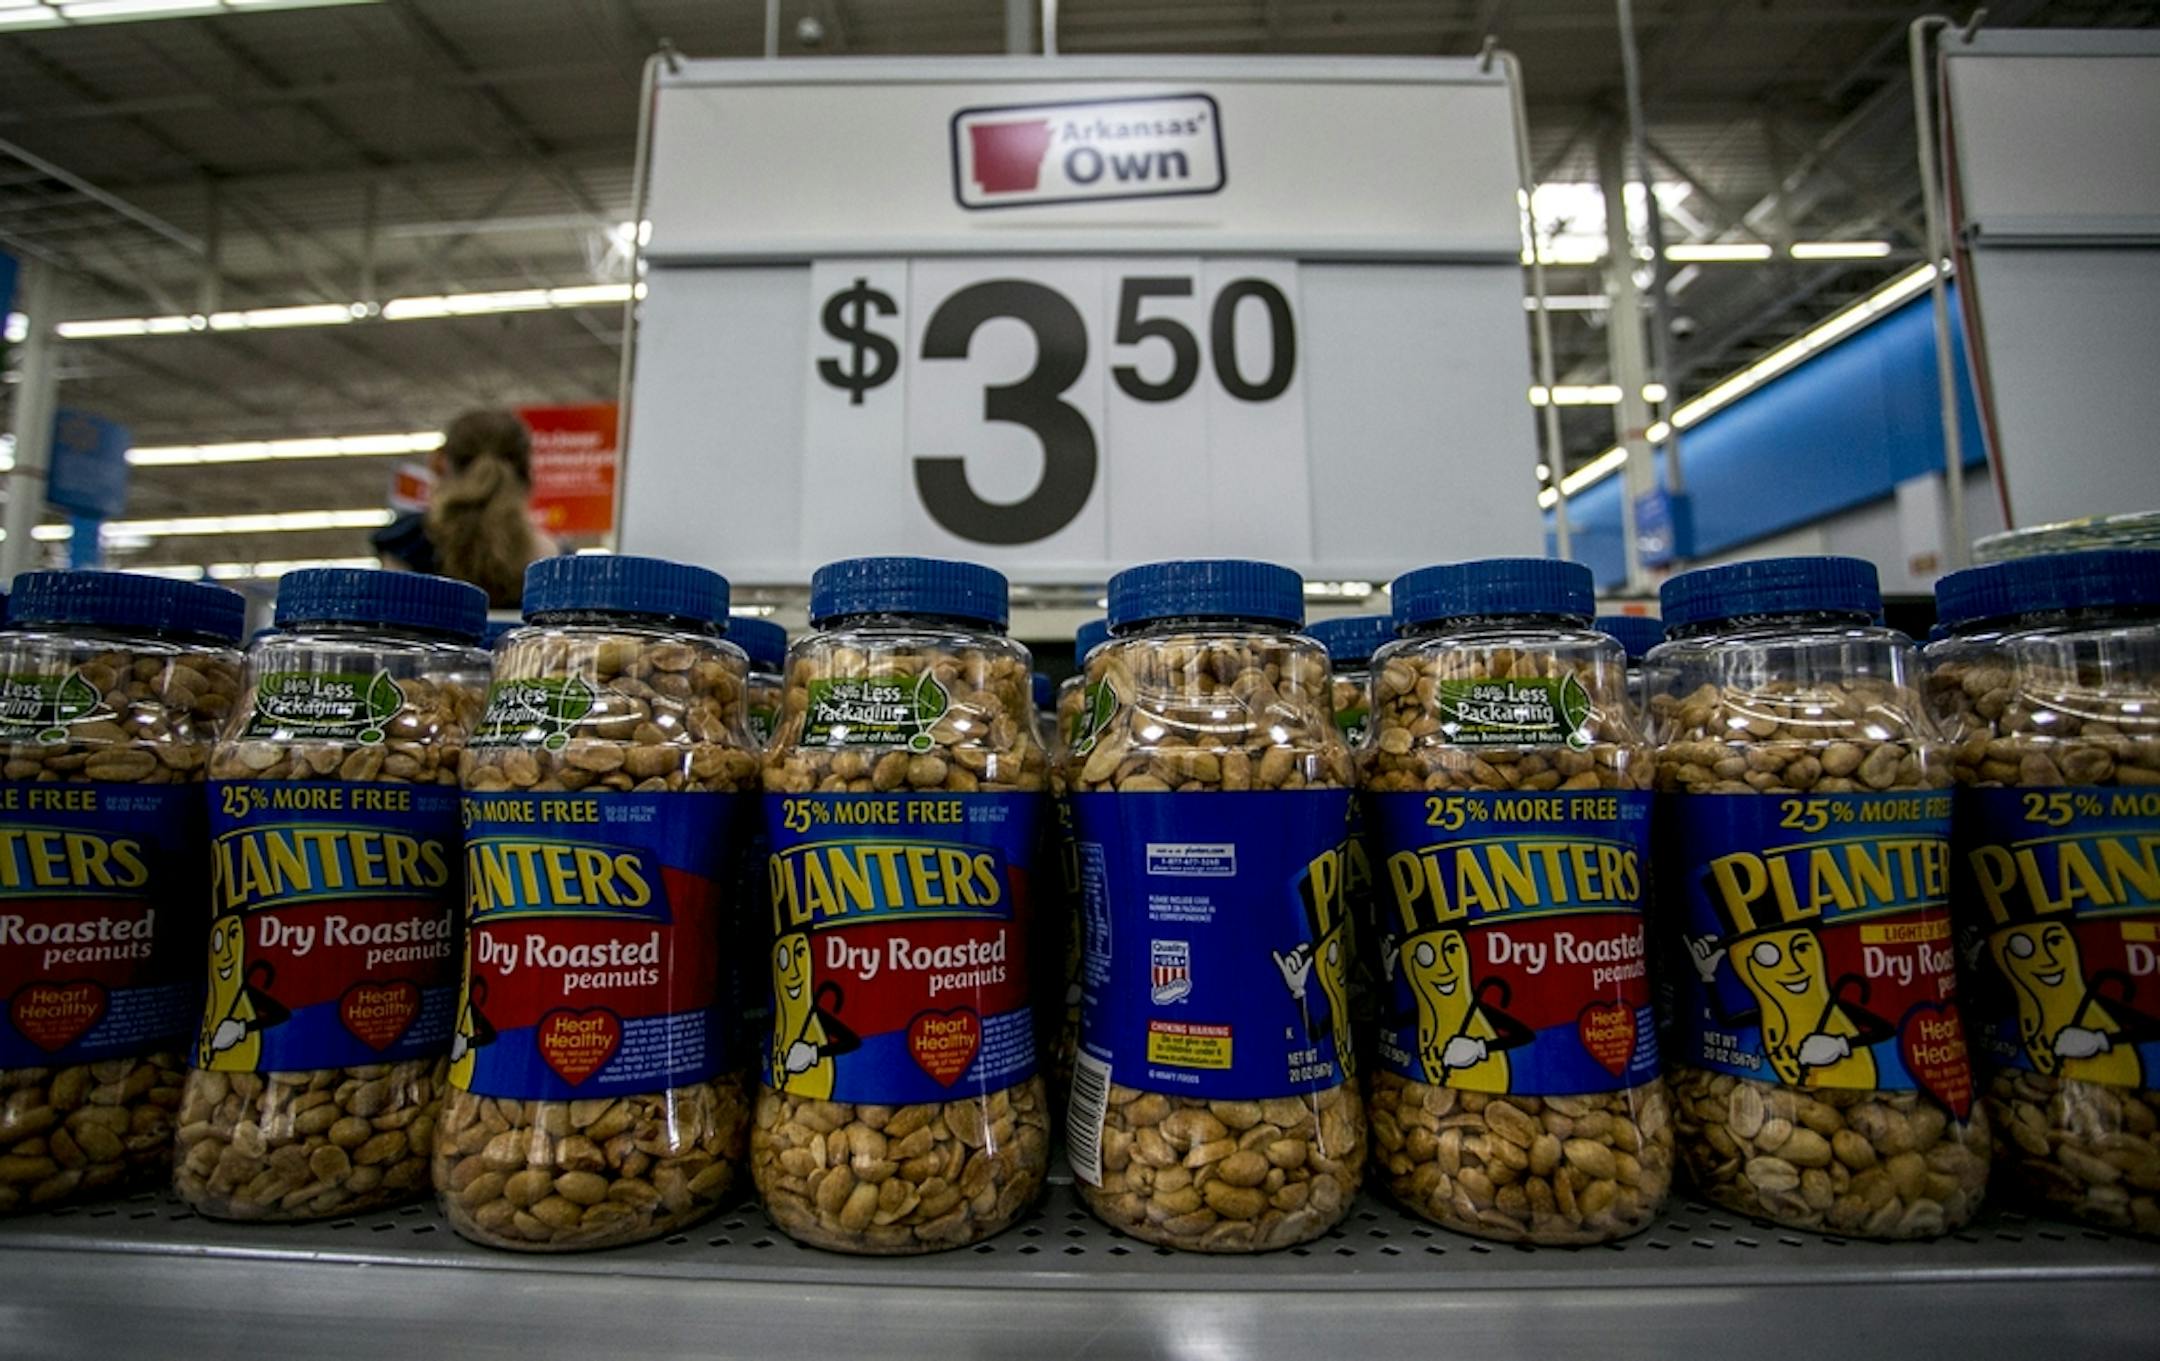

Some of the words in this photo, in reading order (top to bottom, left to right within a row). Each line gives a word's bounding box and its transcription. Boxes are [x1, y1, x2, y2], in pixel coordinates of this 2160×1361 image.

[1064, 146, 1189, 184] Own
[313, 676, 354, 699] Less
[862, 681, 901, 702] Less
[1473, 684, 1506, 702] 84%
[1507, 682, 1548, 703] Less
[29, 789, 98, 811] FREE
[221, 785, 268, 818] 25%
[273, 788, 343, 810] MORE
[352, 789, 411, 812] FREE
[484, 800, 535, 823] MORE
[541, 800, 600, 823] FREE
[1425, 796, 1489, 831] 25%
[1494, 799, 1564, 822] MORE
[1570, 798, 1617, 820] FREE
[2022, 792, 2103, 827] 25%
[783, 799, 829, 833] 25%
[834, 800, 900, 824] MORE
[907, 800, 963, 823] FREE
[1780, 798, 1854, 833] 25%
[1859, 800, 1921, 822] MORE
[210, 828, 449, 919] PLANTERS
[1387, 841, 1642, 934] PLANTERS
[1968, 836, 2160, 924] PLAN
[769, 845, 1001, 937] PLANTERS
[0, 909, 156, 945] Roasted
[259, 915, 316, 957] Dry
[324, 909, 453, 947] Roasted
[43, 942, 152, 971] peanuts
[366, 941, 452, 971] peanuts
[478, 931, 518, 976] Dry
[525, 931, 660, 969] Roasted
[825, 935, 881, 980] Dry
[888, 929, 1006, 971] Roasted
[1153, 943, 1187, 954] Quality
[1160, 956, 1181, 966] USA
[1487, 932, 1547, 974] Dry
[1554, 924, 1645, 965] Roasted
[929, 964, 1006, 997] peanuts
[1592, 961, 1646, 990] peanuts
[1863, 945, 1913, 987] Dry
[33, 988, 89, 1004] Heart
[358, 987, 406, 1004] Heart
[563, 967, 660, 996] peanuts
[19, 1001, 99, 1019] Healthy
[349, 1001, 414, 1020] Healthy
[555, 1016, 605, 1033] Heart
[924, 1016, 968, 1034] Heart
[1150, 1021, 1187, 1035] CHOKING
[1188, 1024, 1230, 1037] WARNING
[545, 1031, 614, 1050] Healthy
[915, 1033, 976, 1052] Healthy
[1703, 1030, 1721, 1046] NET
[1721, 1034, 1738, 1050] WT
[1716, 1048, 1729, 1063] OZ
